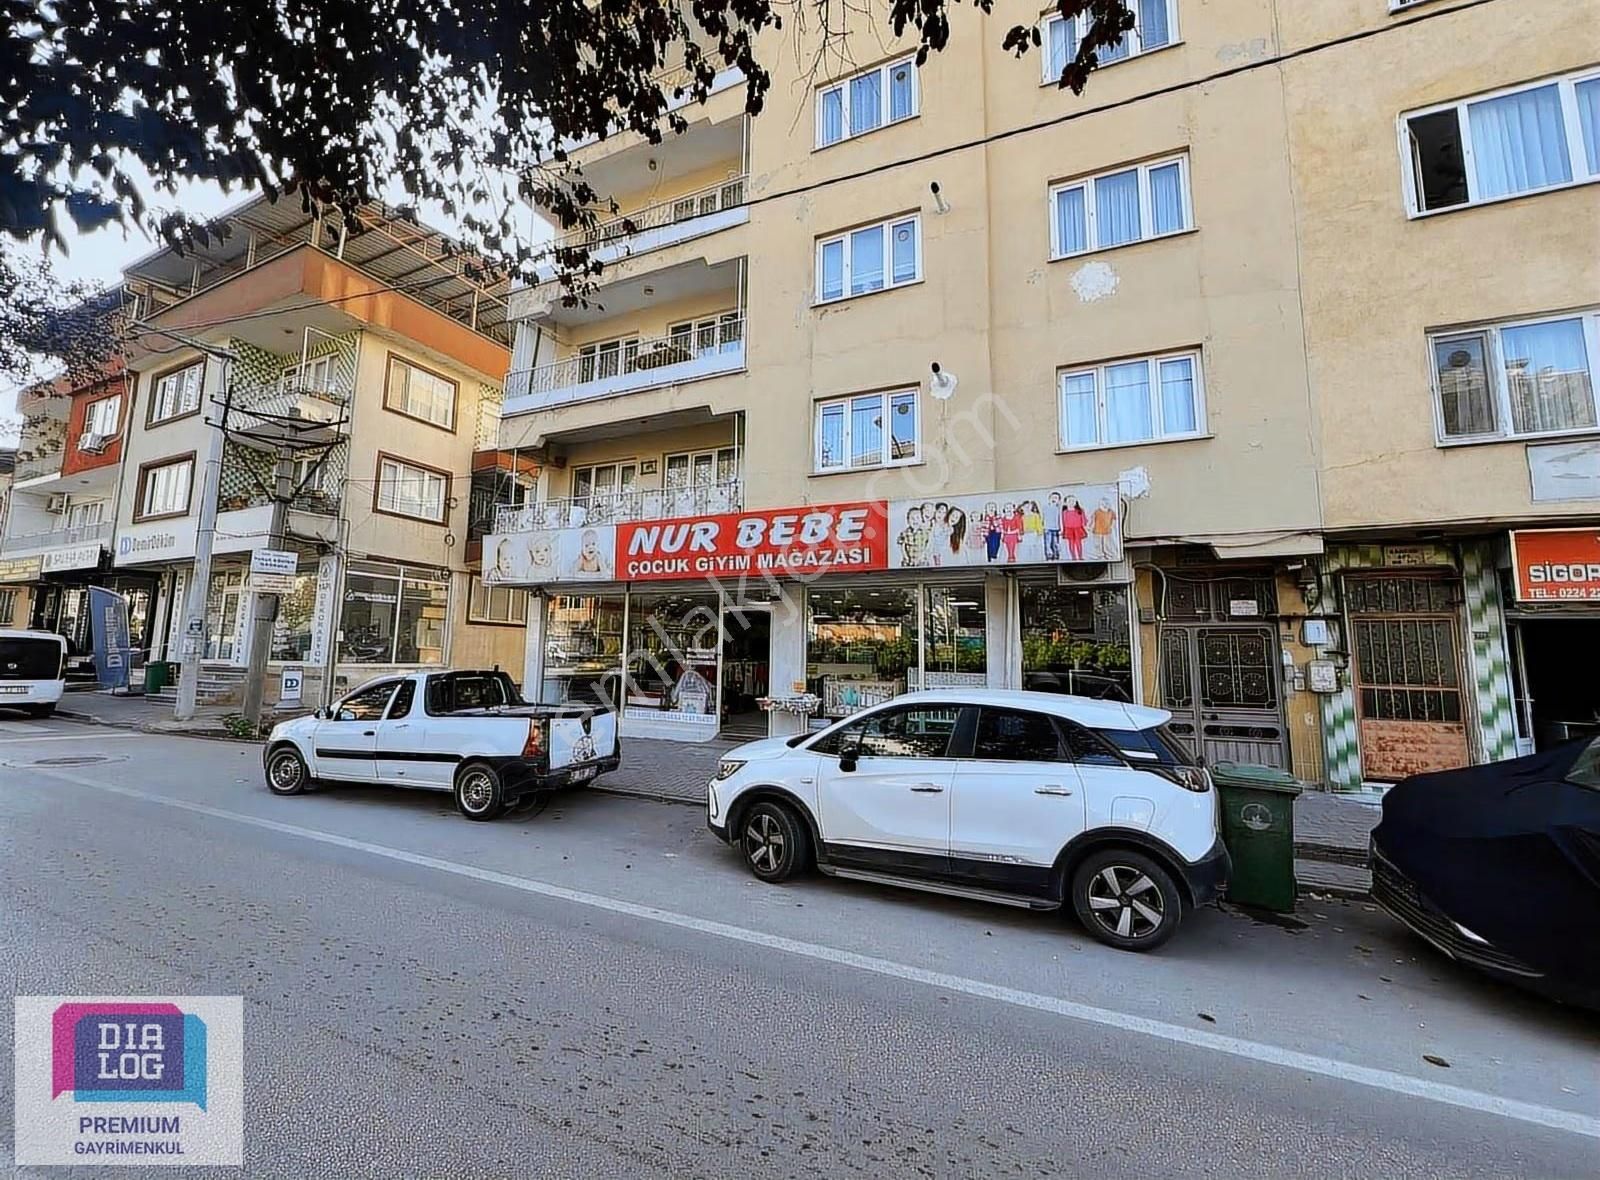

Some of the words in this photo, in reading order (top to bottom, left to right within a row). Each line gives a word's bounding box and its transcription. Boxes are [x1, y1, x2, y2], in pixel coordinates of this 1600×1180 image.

[628, 521, 720, 556] NUR
[735, 508, 869, 549] BEBE
[627, 557, 690, 577] ÇOCUK
[756, 546, 872, 570] MAĞAZASI
[1560, 587, 1587, 598] 0224
